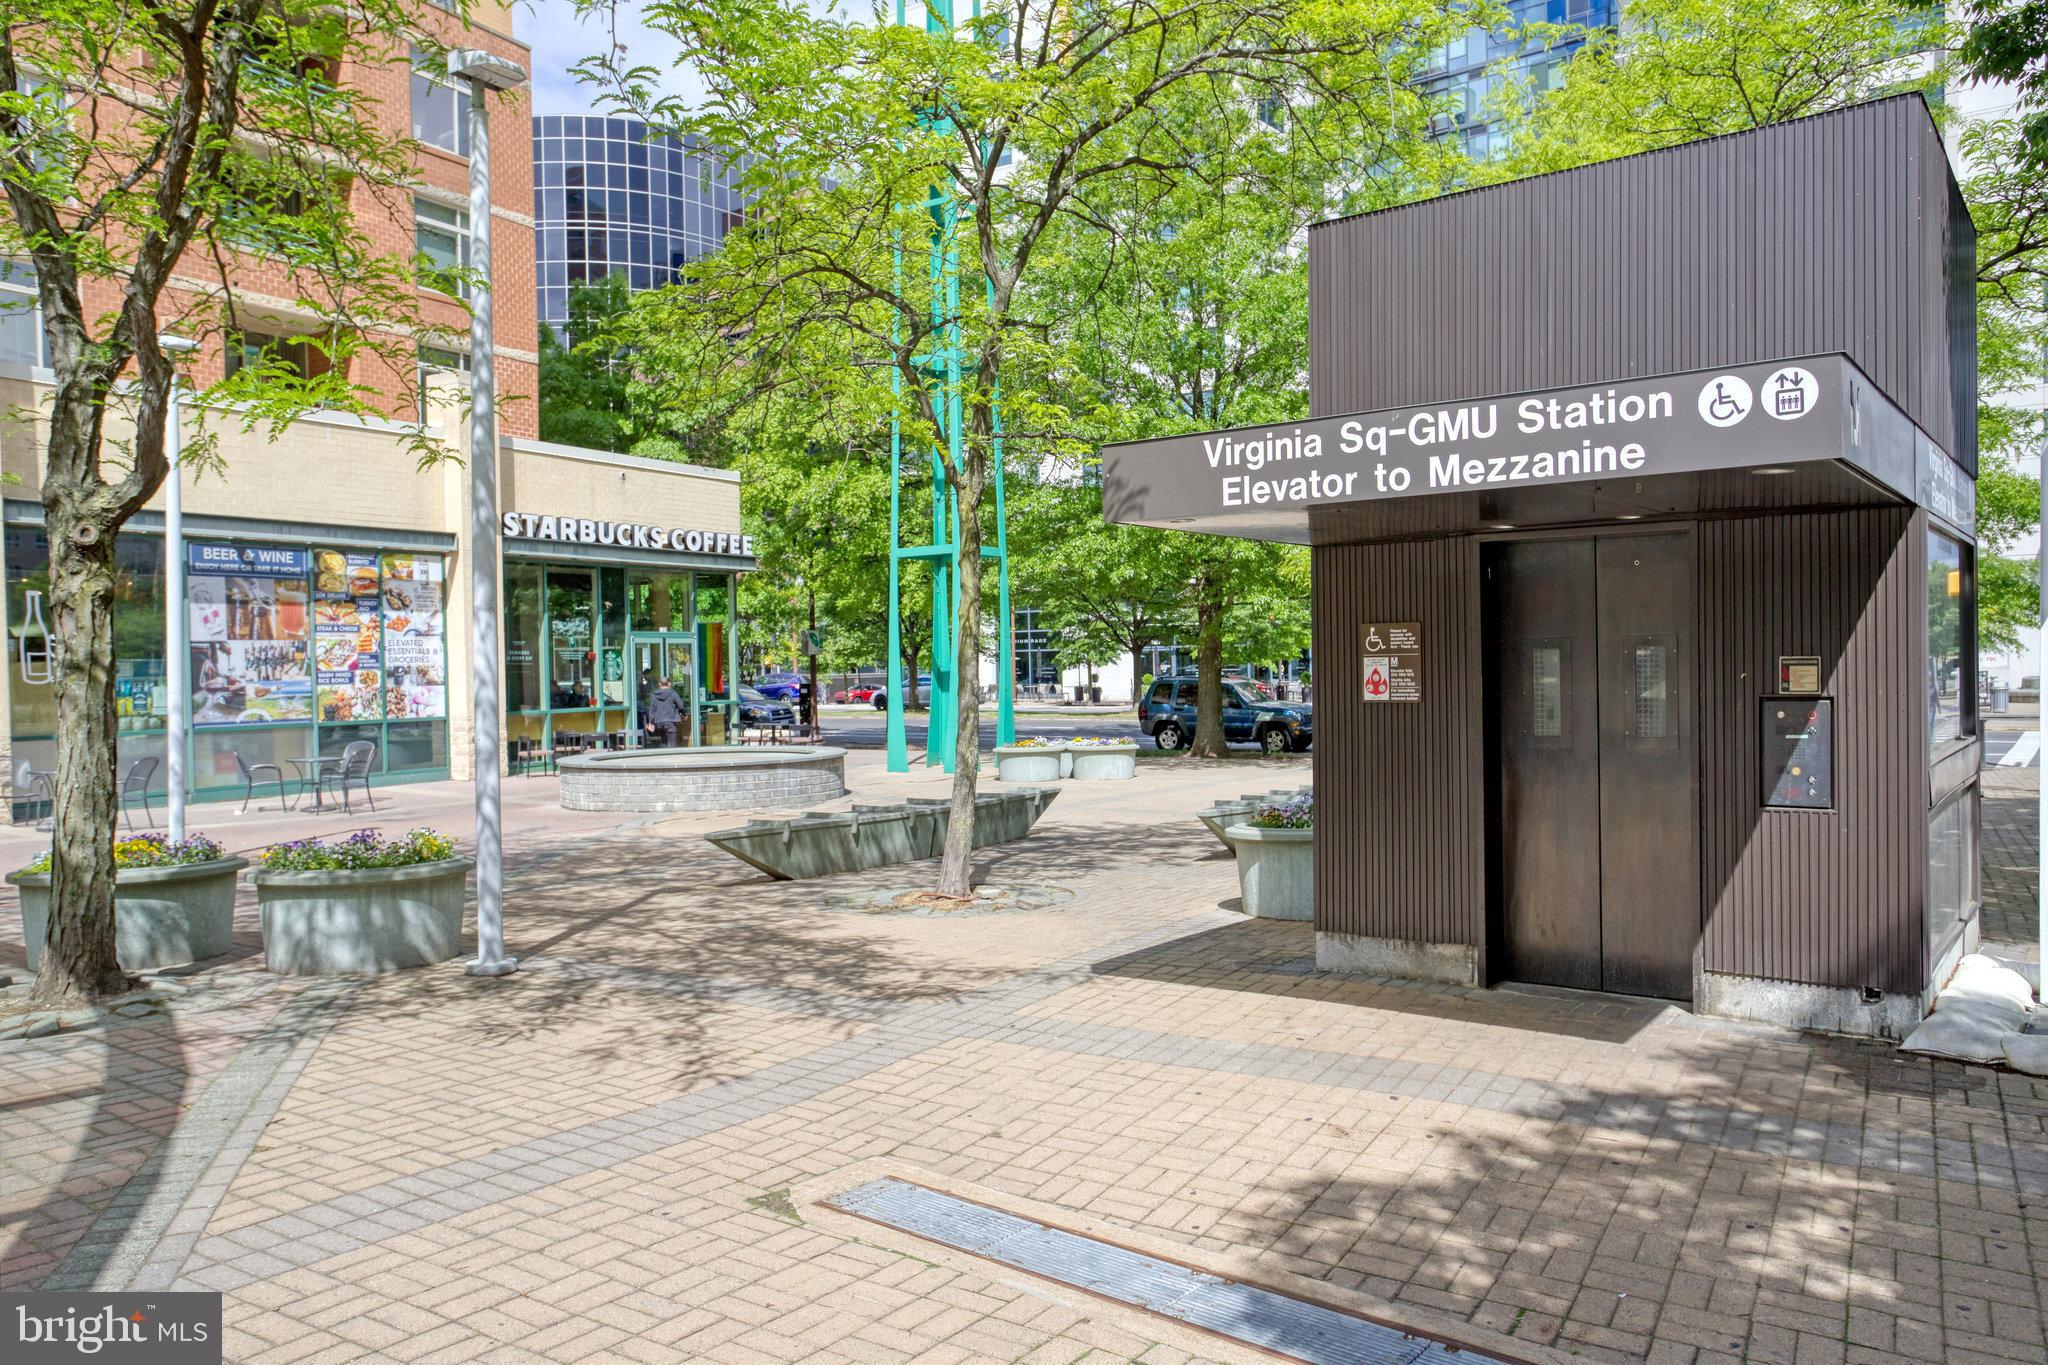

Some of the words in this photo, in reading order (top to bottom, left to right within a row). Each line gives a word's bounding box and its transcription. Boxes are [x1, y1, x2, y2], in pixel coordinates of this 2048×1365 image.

[1203, 429, 1322, 470] Virginia
[1339, 404, 1497, 456] Sq-GMU
[1517, 389, 1672, 434] Station
[1222, 470, 1357, 506] Elevator
[1374, 463, 1410, 492] to
[1430, 439, 1646, 488] Mezzanine
[203, 547, 238, 560] BEER
[243, 549, 255, 561] &
[258, 551, 294, 563] WINE
[502, 512, 664, 548] STARBUCKS
[670, 528, 753, 555] COFFEE
[195, 562, 219, 570] ENJOY
[221, 563, 239, 571] HERE
